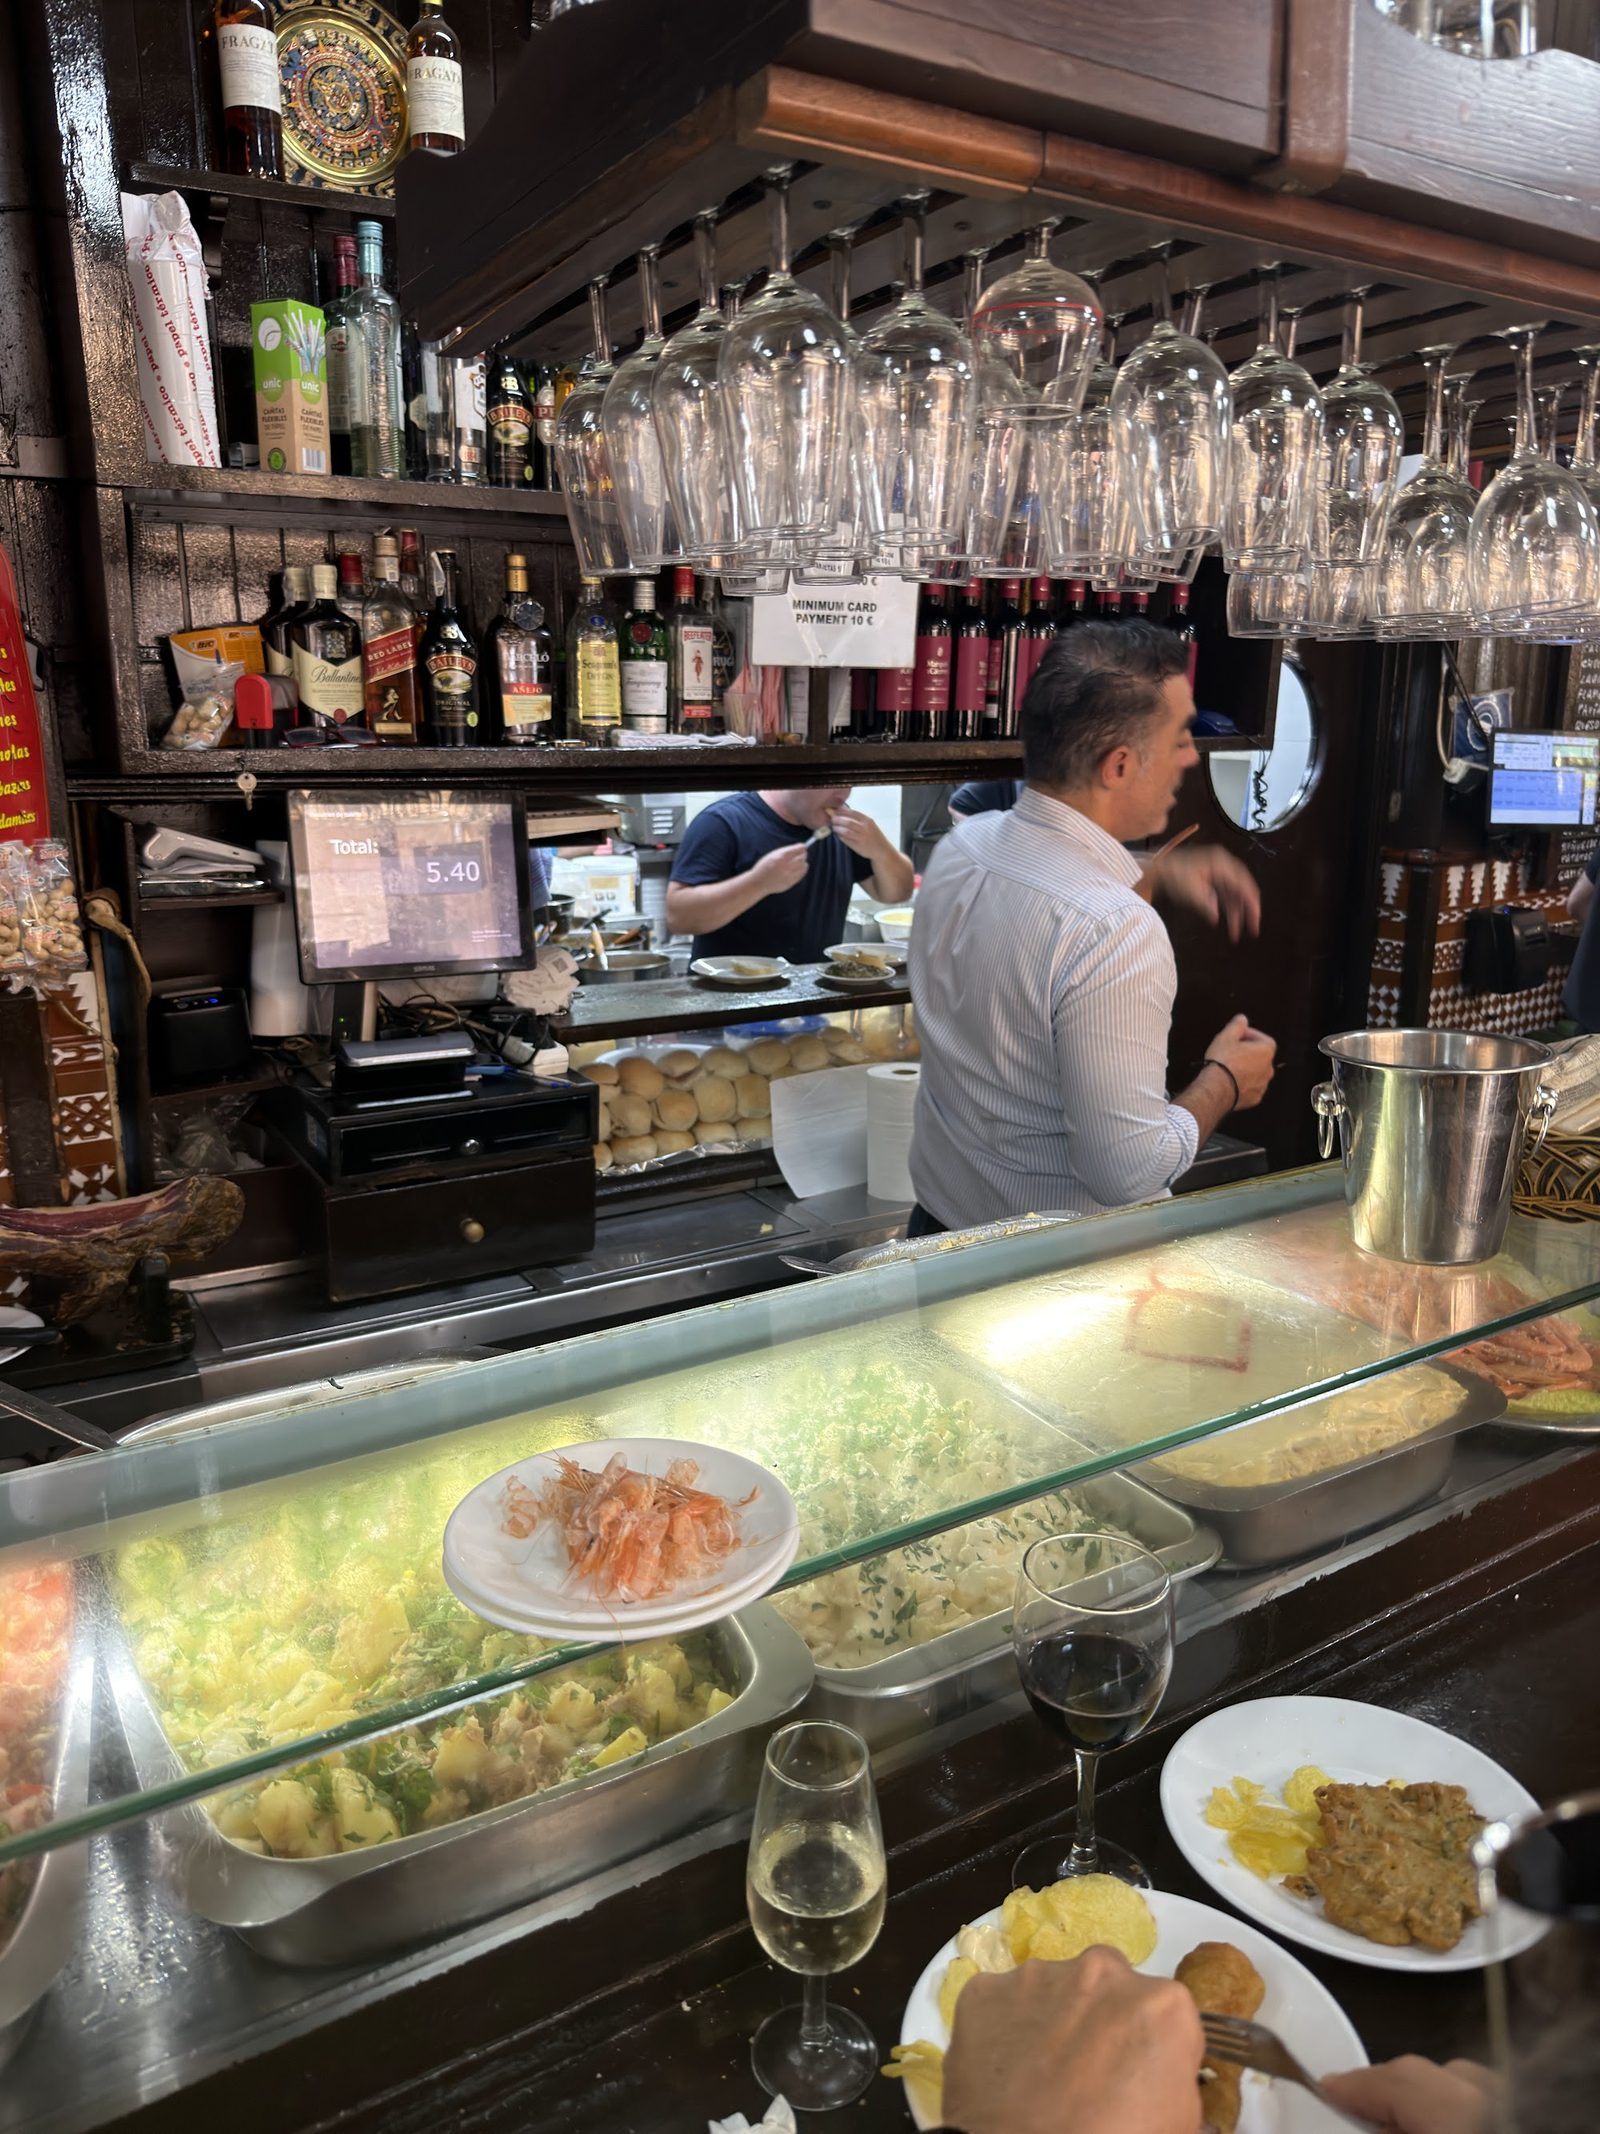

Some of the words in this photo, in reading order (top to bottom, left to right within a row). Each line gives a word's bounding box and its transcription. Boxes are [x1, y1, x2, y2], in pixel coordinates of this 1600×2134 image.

[221, 34, 275, 54] FRAGAT
[409, 66, 461, 84] RAGAT
[301, 380, 320, 393] unic
[185, 439, 205, 466] apel
[792, 600, 845, 611] MINIMUM
[847, 602, 878, 612] CARD
[796, 613, 848, 625] PAYMENT
[851, 615, 864, 625] 10
[866, 616, 875, 626] €
[368, 650, 385, 662] RED
[387, 641, 414, 655] LABEL
[430, 656, 474, 671] BAILEYS
[511, 684, 544, 694] AÑEJO
[330, 838, 379, 855] Total:
[426, 861, 481, 884] 5.40
